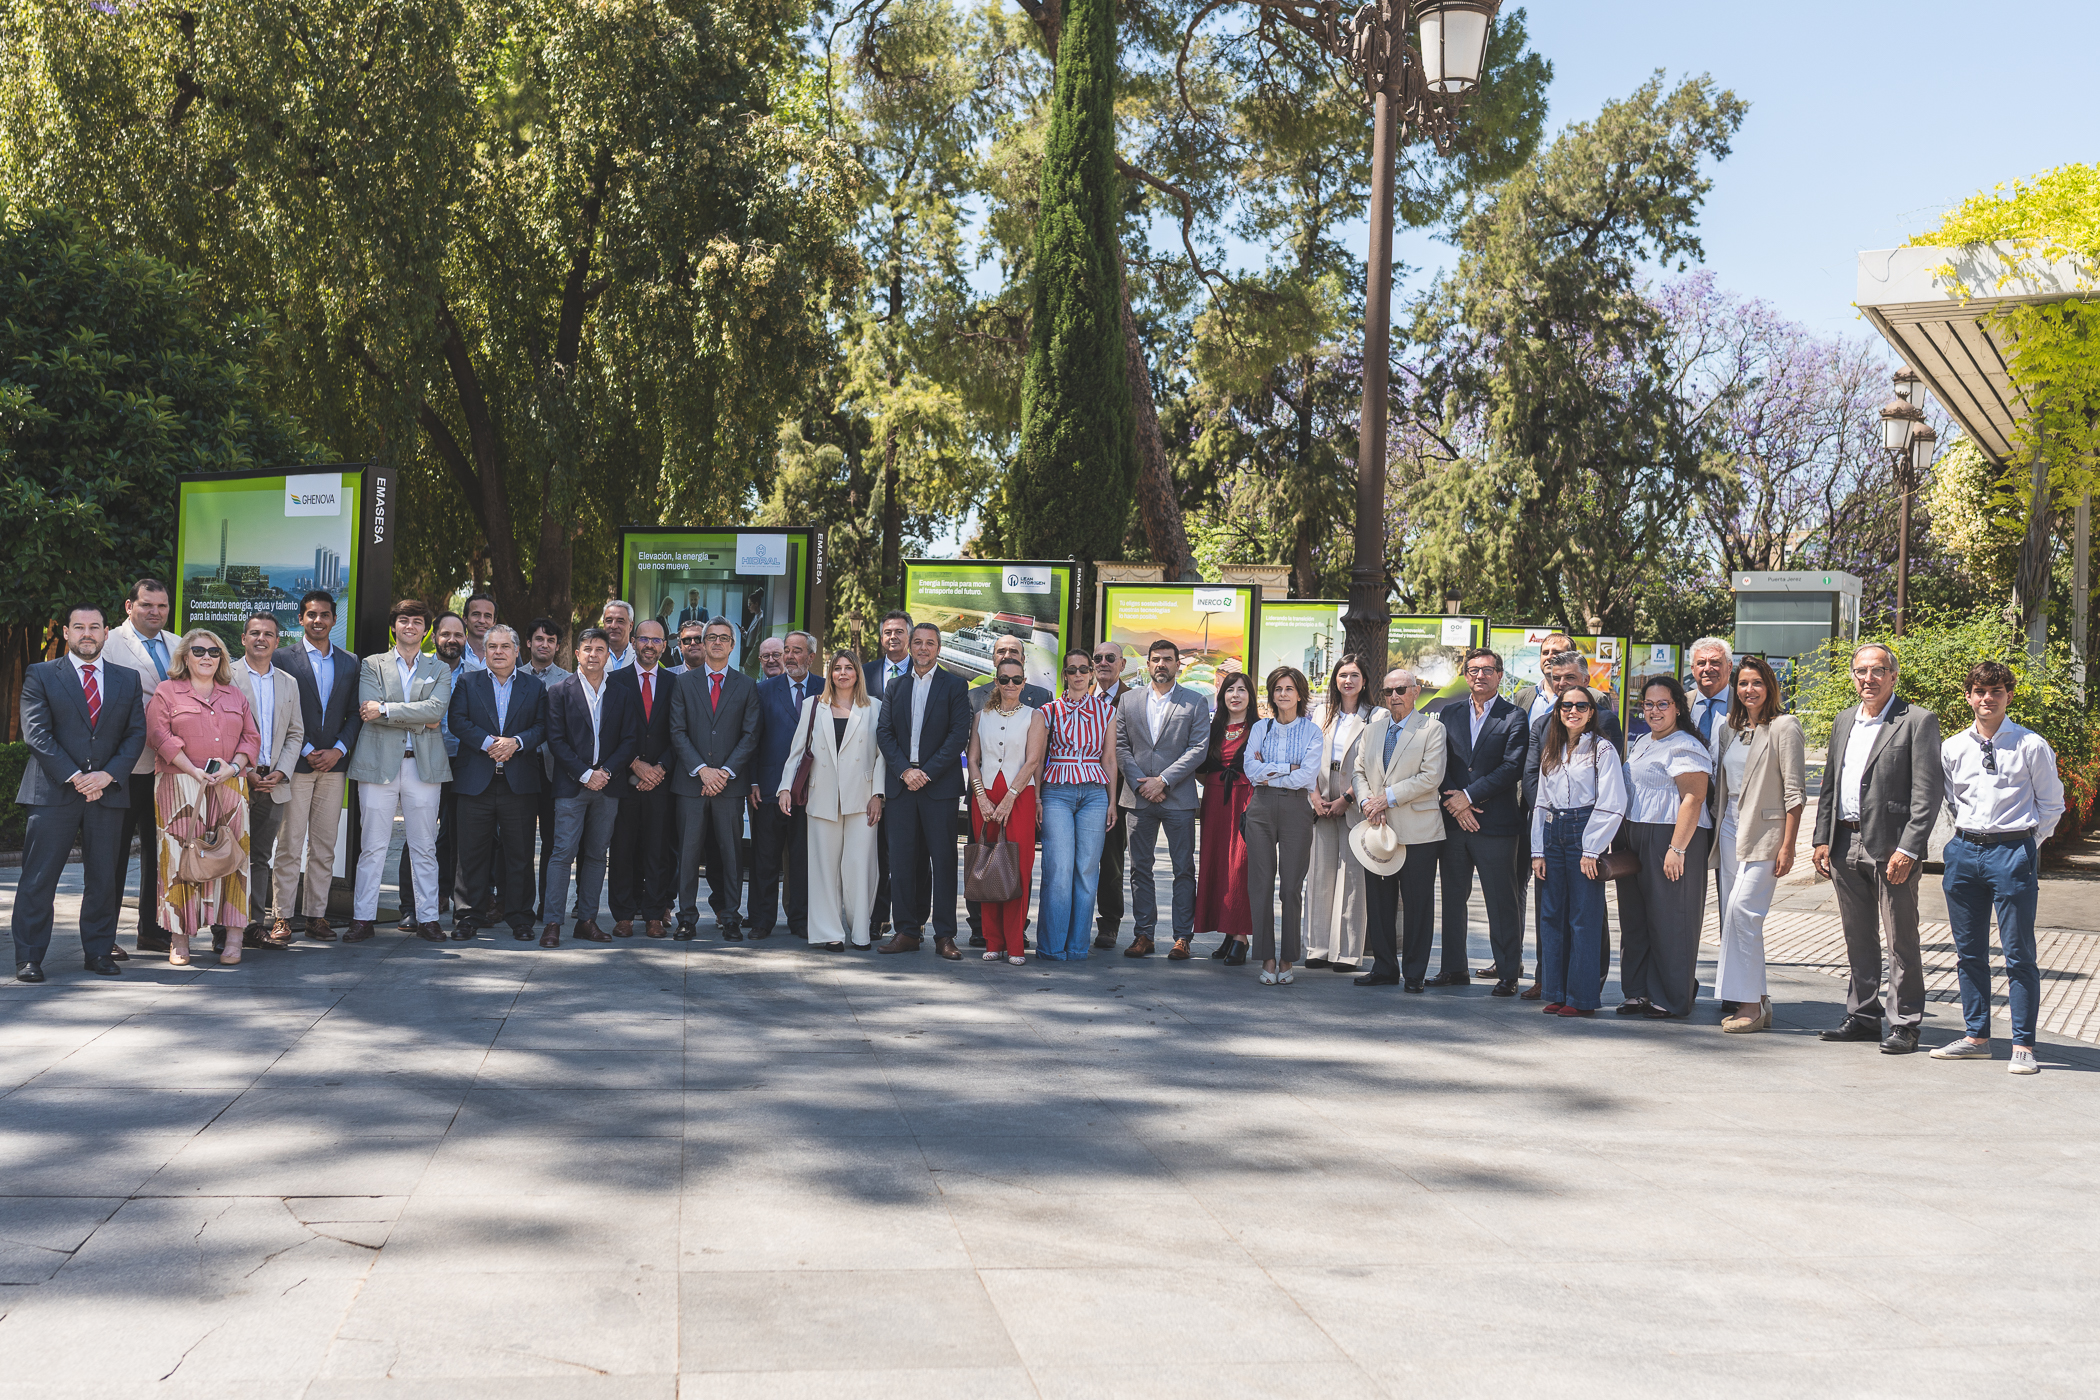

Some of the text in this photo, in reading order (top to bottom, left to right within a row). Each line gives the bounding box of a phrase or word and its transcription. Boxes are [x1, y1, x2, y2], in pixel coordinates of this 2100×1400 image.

[302, 493, 335, 505] GHENOVA
[373, 477, 387, 545] EMASESA
[638, 551, 709, 562] Elevación, la energía
[741, 556, 781, 565] HIDRAL
[816, 533, 824, 585] EMASESA
[638, 562, 691, 571] que nos mueve.
[919, 579, 940, 588] Energía
[941, 579, 958, 588] limpia
[924, 587, 953, 595] transporte
[954, 587, 963, 595] del
[190, 599, 299, 612] Conectando energía, agua y talento
[1197, 598, 1222, 606] INERCO
[189, 612, 204, 623] para
[204, 611, 210, 621] la
[210, 611, 238, 621] industria
[238, 612, 248, 621] del
